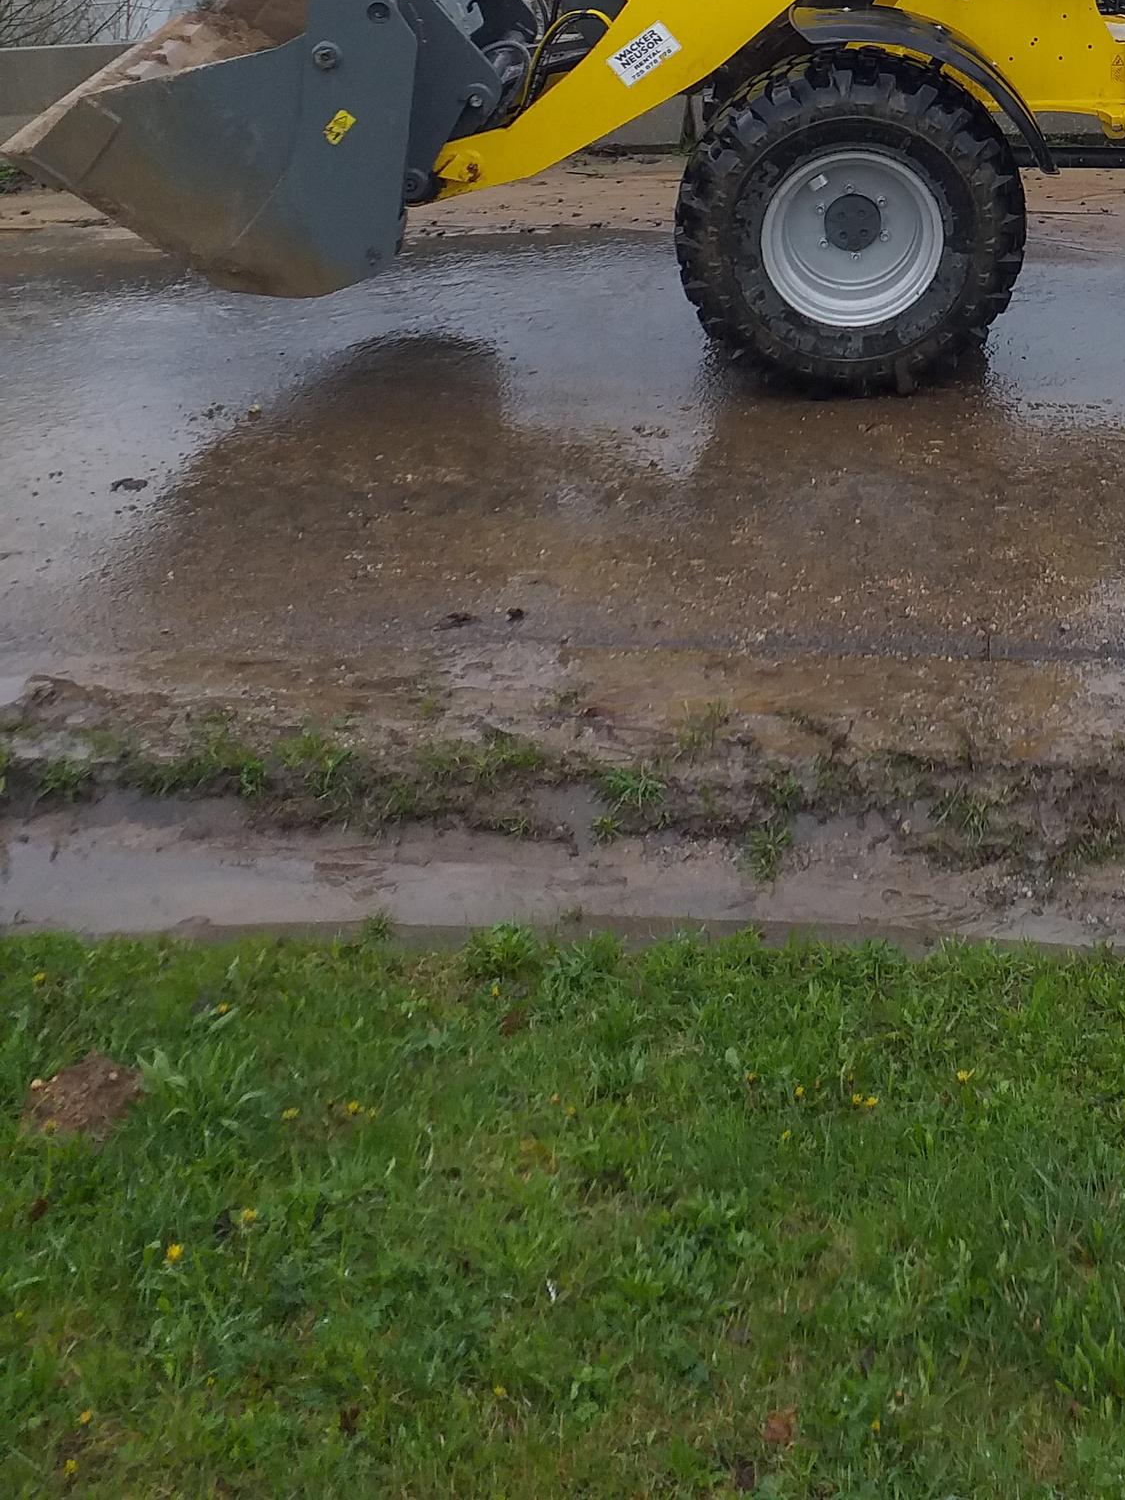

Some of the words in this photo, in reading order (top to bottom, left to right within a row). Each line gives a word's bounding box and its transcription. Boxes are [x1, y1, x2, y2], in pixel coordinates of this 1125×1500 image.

[614, 29, 657, 62] WACKER
[620, 35, 663, 69] NEUSON
[634, 49, 661, 70] RENTAL
